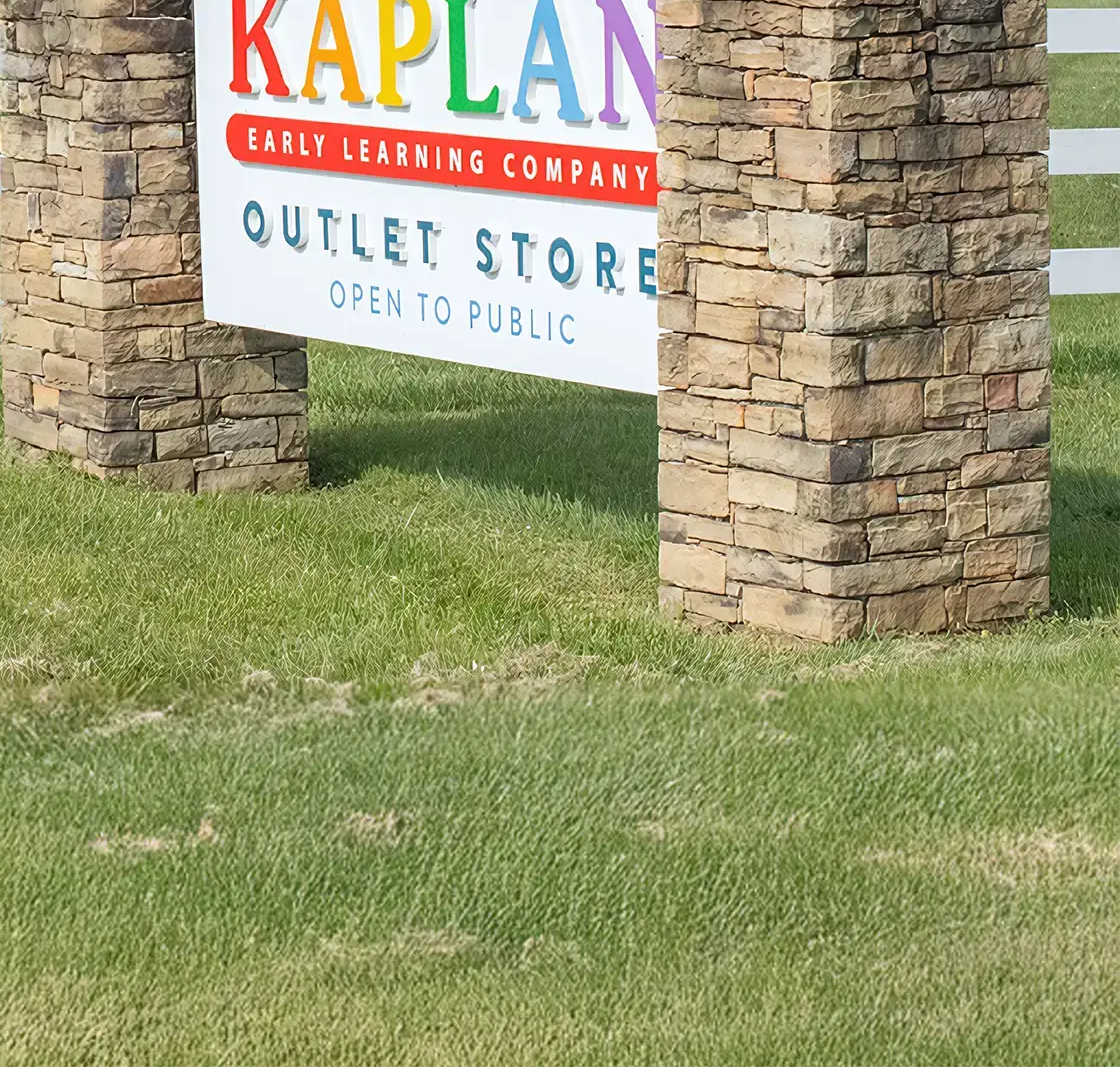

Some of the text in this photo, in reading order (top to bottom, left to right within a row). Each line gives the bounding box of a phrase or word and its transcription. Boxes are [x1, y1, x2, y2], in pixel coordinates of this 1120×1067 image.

[248, 127, 649, 191] EARLY LEARNING COMPANY
[243, 200, 657, 295] OUTLET STORE
[330, 280, 575, 344] OPEN TO PUBLIC
